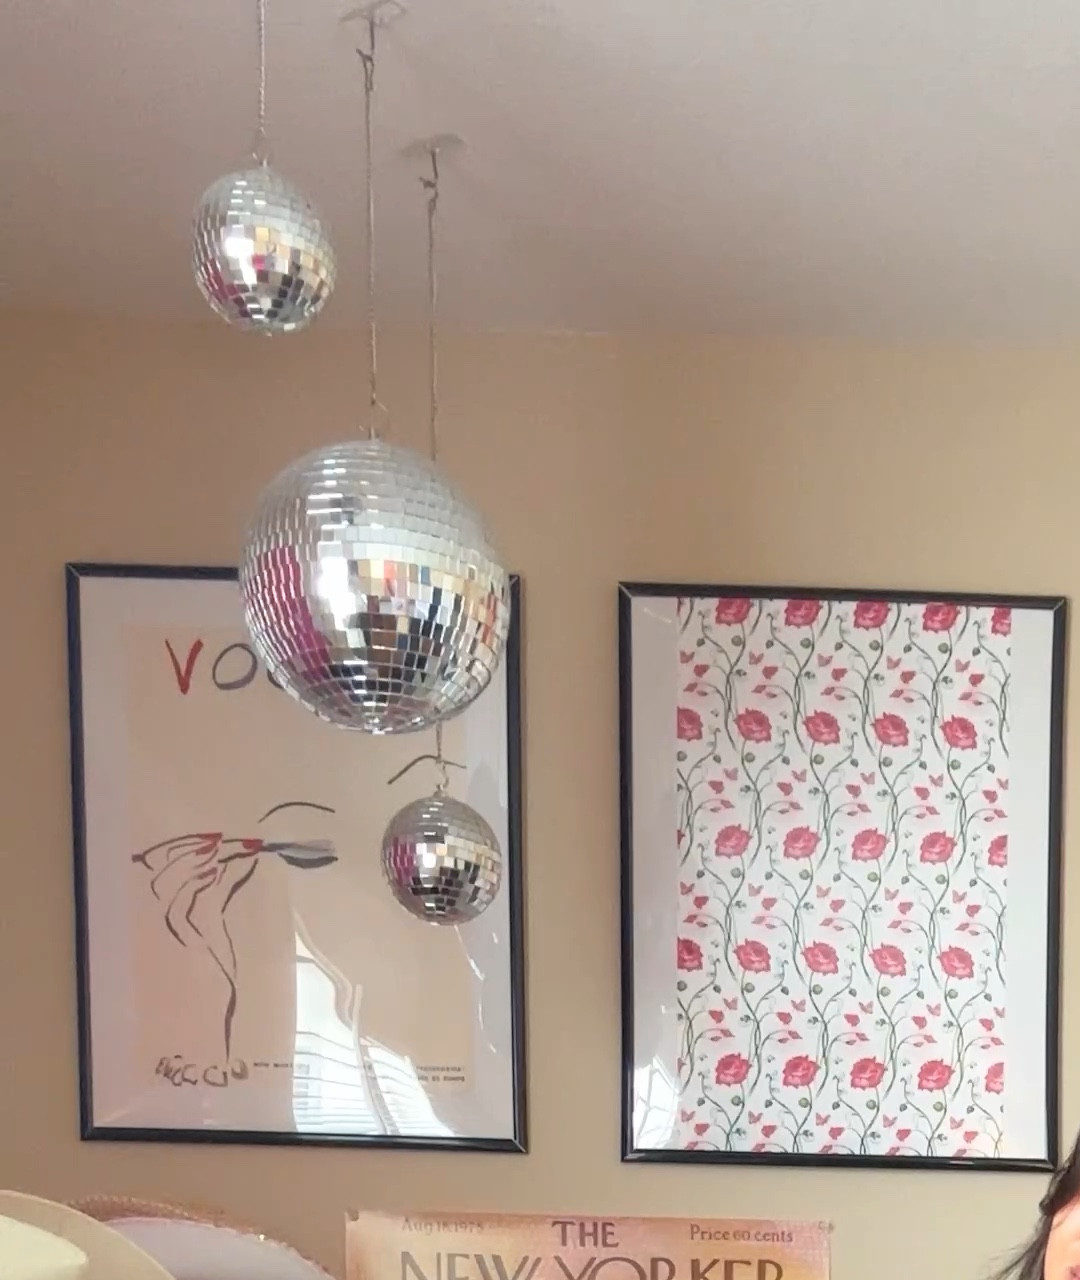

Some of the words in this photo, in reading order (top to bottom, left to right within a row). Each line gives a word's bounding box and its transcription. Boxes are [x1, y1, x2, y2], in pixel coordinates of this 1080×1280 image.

[552, 1220, 620, 1248] THE
[690, 1223, 730, 1241] Price
[732, 1230, 751, 1241] 60
[754, 1229, 793, 1243] cents
